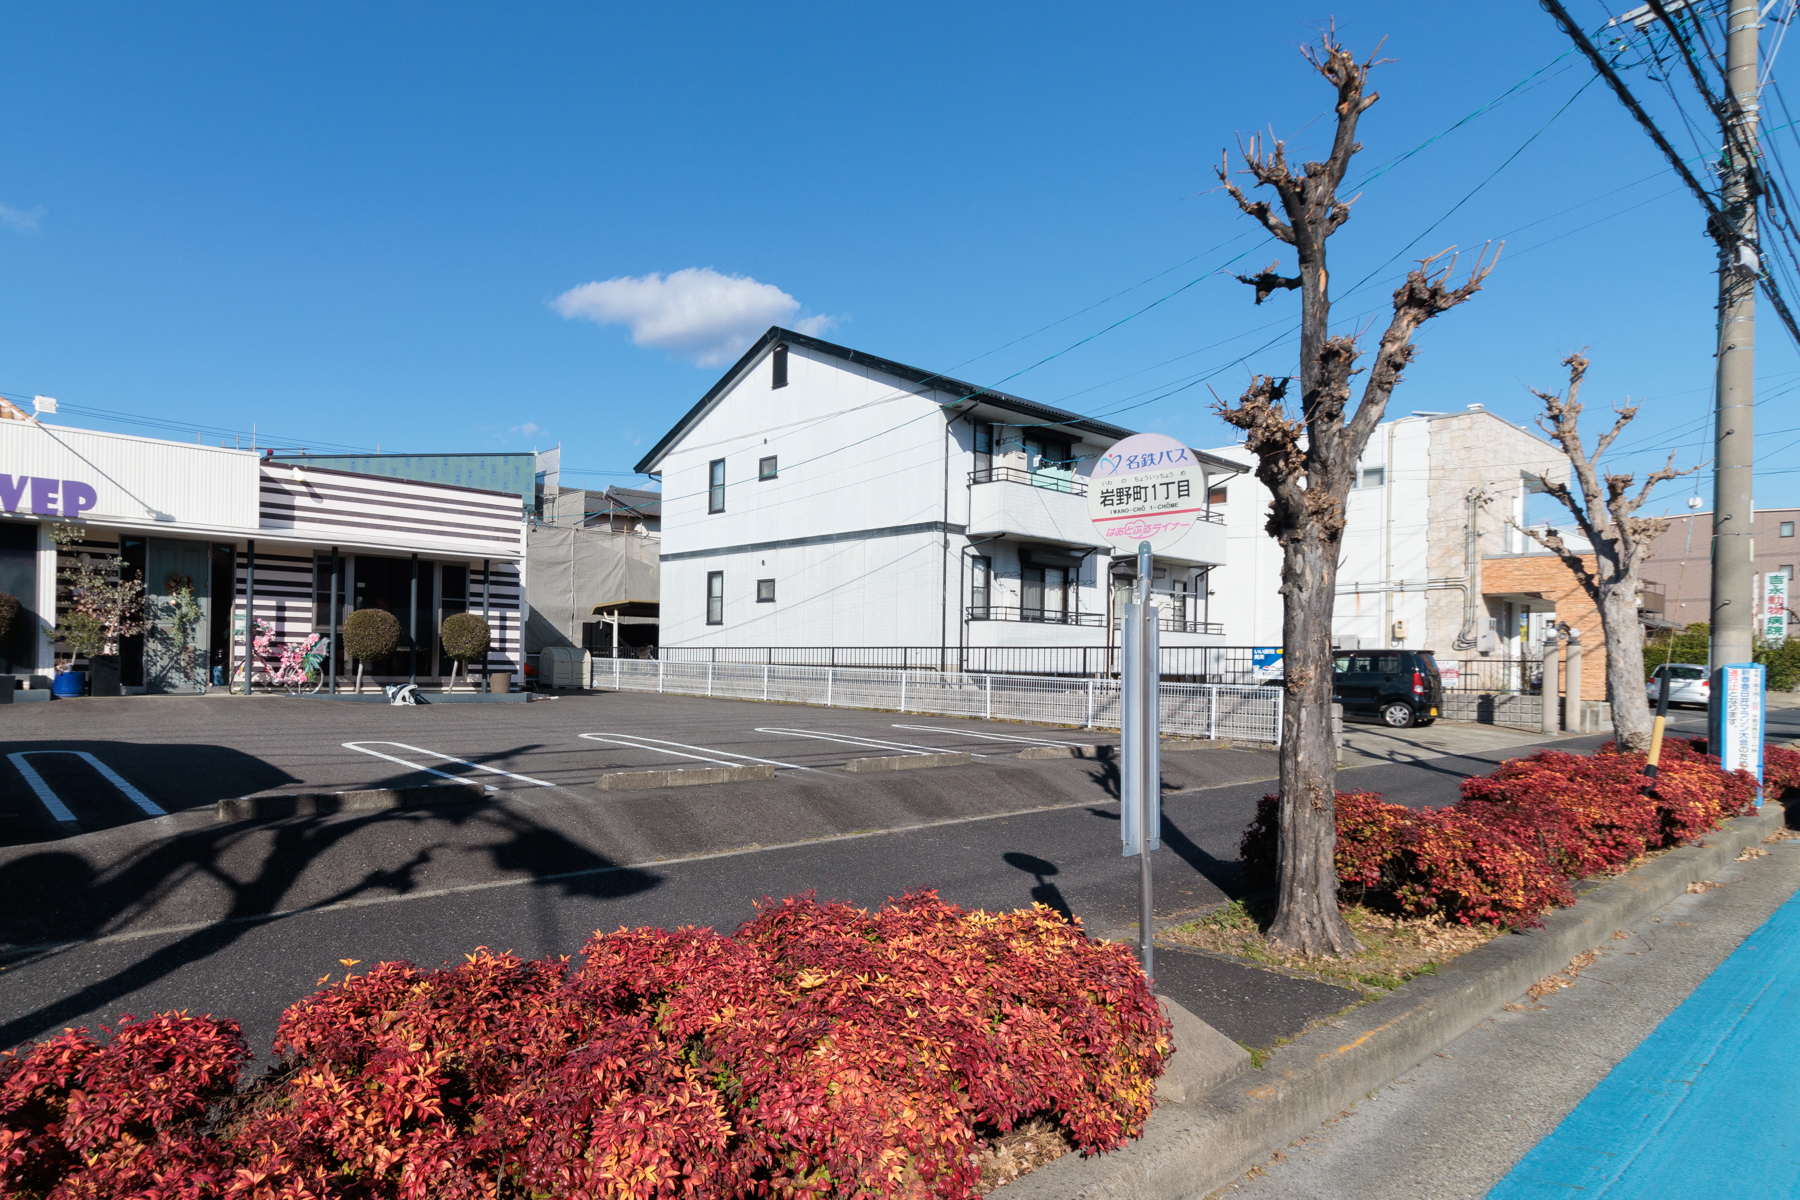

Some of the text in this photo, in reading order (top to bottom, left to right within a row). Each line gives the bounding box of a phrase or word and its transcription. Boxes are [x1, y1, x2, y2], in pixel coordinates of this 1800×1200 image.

[1126, 448, 1188, 469] 名鉄バス
[1100, 479, 1190, 507] 岩野町1丁目
[1106, 521, 1190, 537] はあとふるライナー
[1766, 575, 1785, 636] 吉永動物病院
